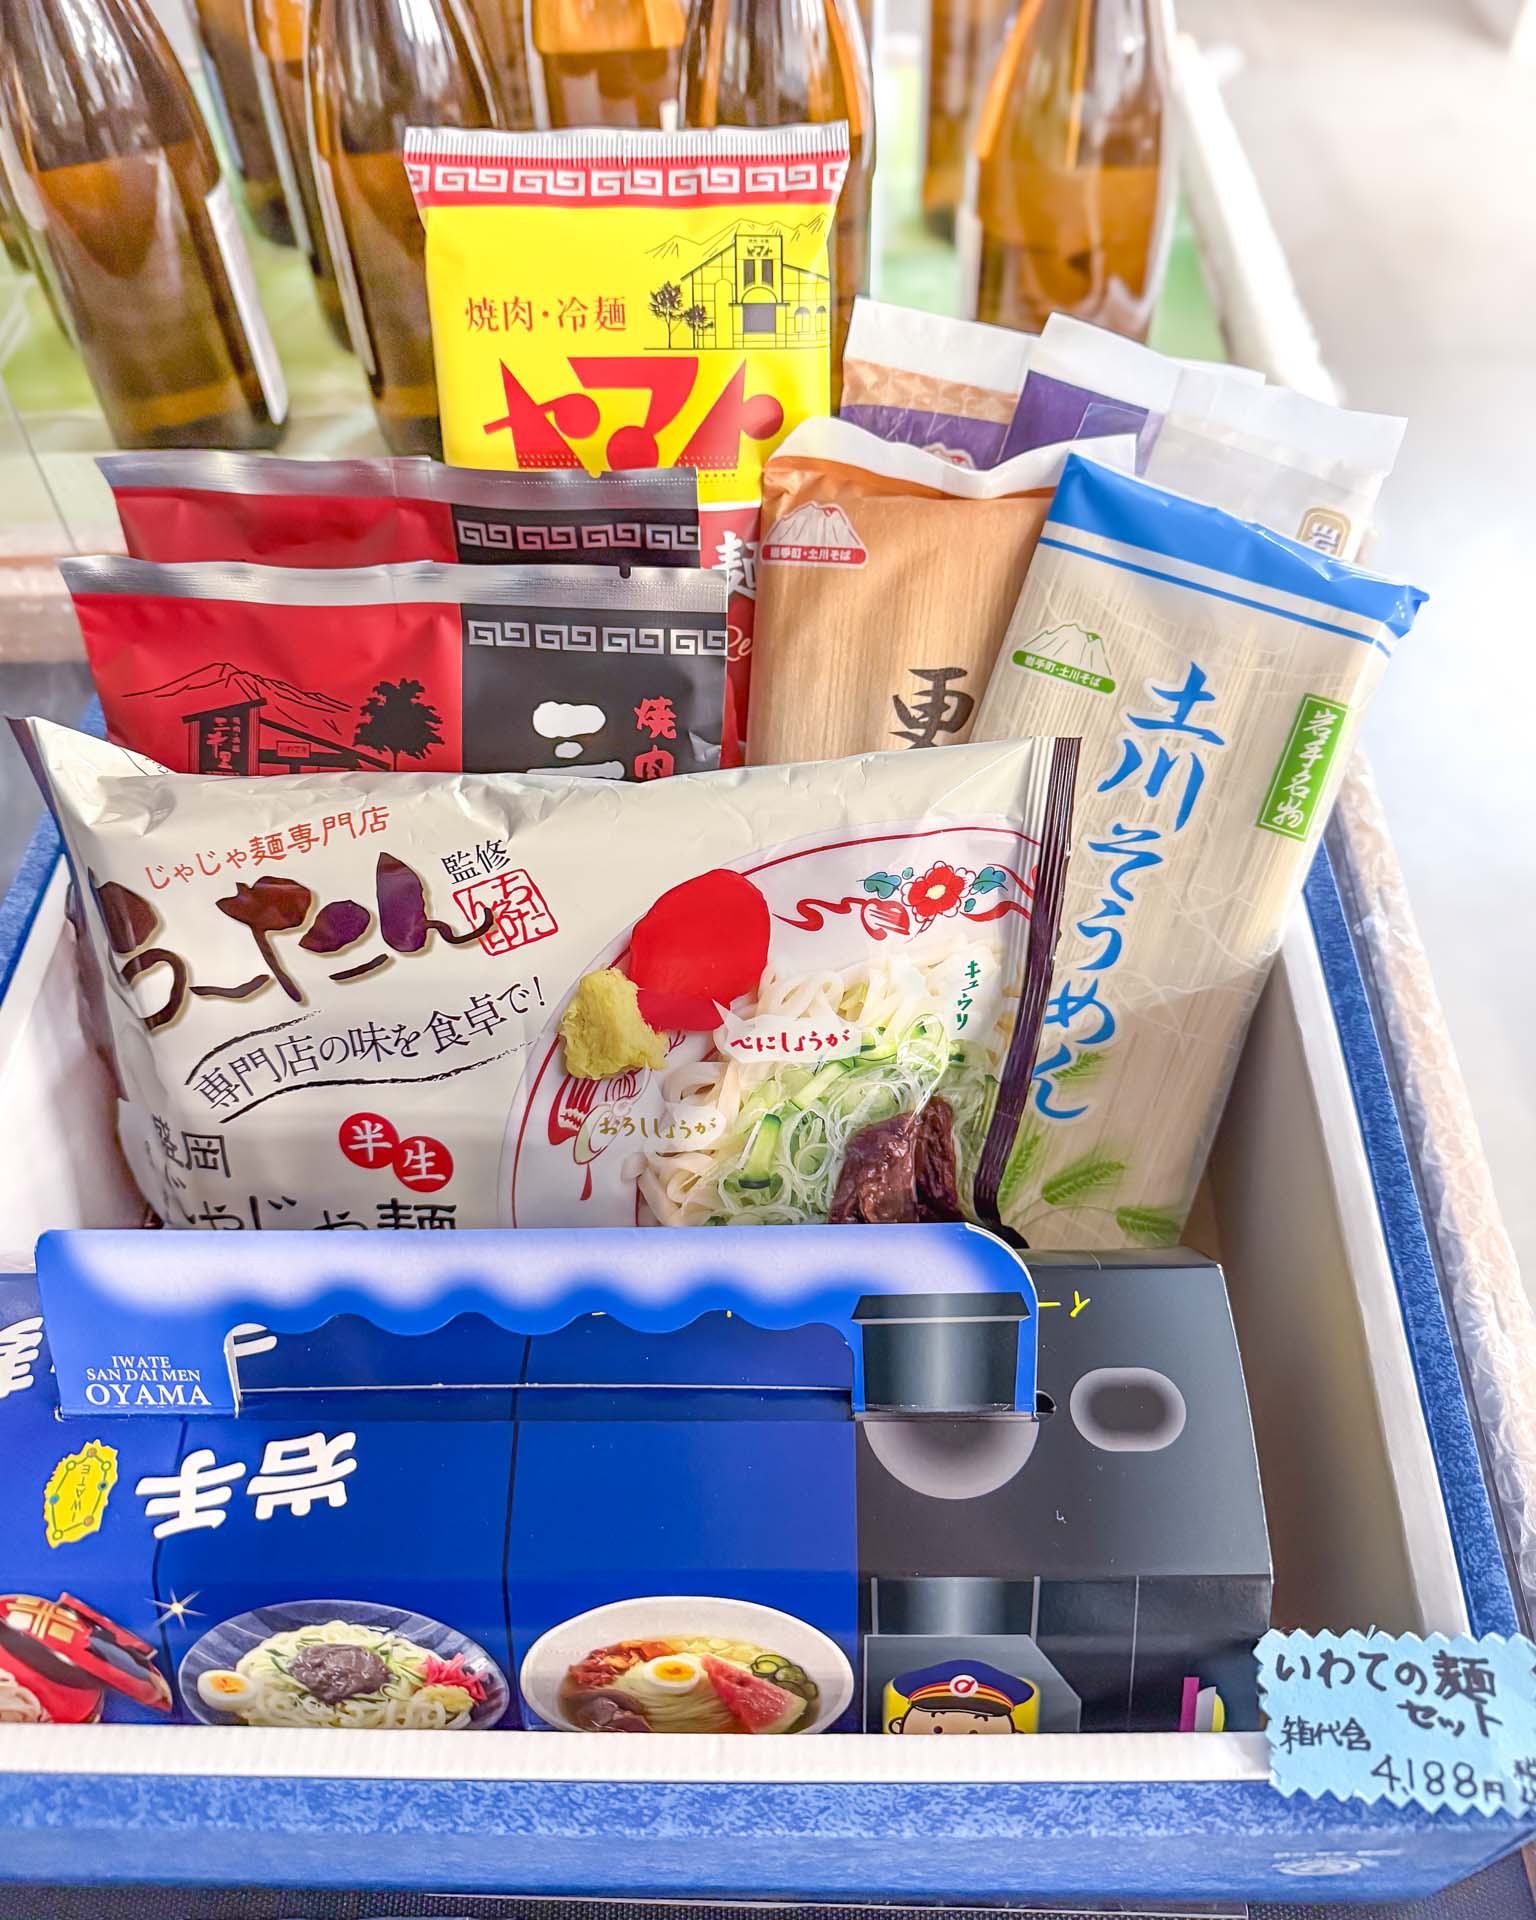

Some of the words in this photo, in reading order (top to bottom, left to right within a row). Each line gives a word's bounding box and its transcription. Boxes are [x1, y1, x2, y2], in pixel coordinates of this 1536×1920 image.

[465, 296, 627, 333] 焼肉・冷麺
[1271, 707, 1339, 830] 岩手名物
[145, 804, 391, 891] じゃじゃ麺専門店
[441, 839, 512, 885] 監修
[1032, 660, 1226, 1120] 土川そうめん
[86, 1368, 120, 1382] SAN
[125, 1368, 157, 1382] DAI
[162, 1368, 200, 1382] MEN
[112, 1355, 172, 1369] IWATE
[85, 1383, 212, 1406] OYAMA
[1275, 1649, 1497, 1701] いわての麺
[1280, 1715, 1372, 1754] 箱代含
[1397, 1699, 1503, 1738] セット
